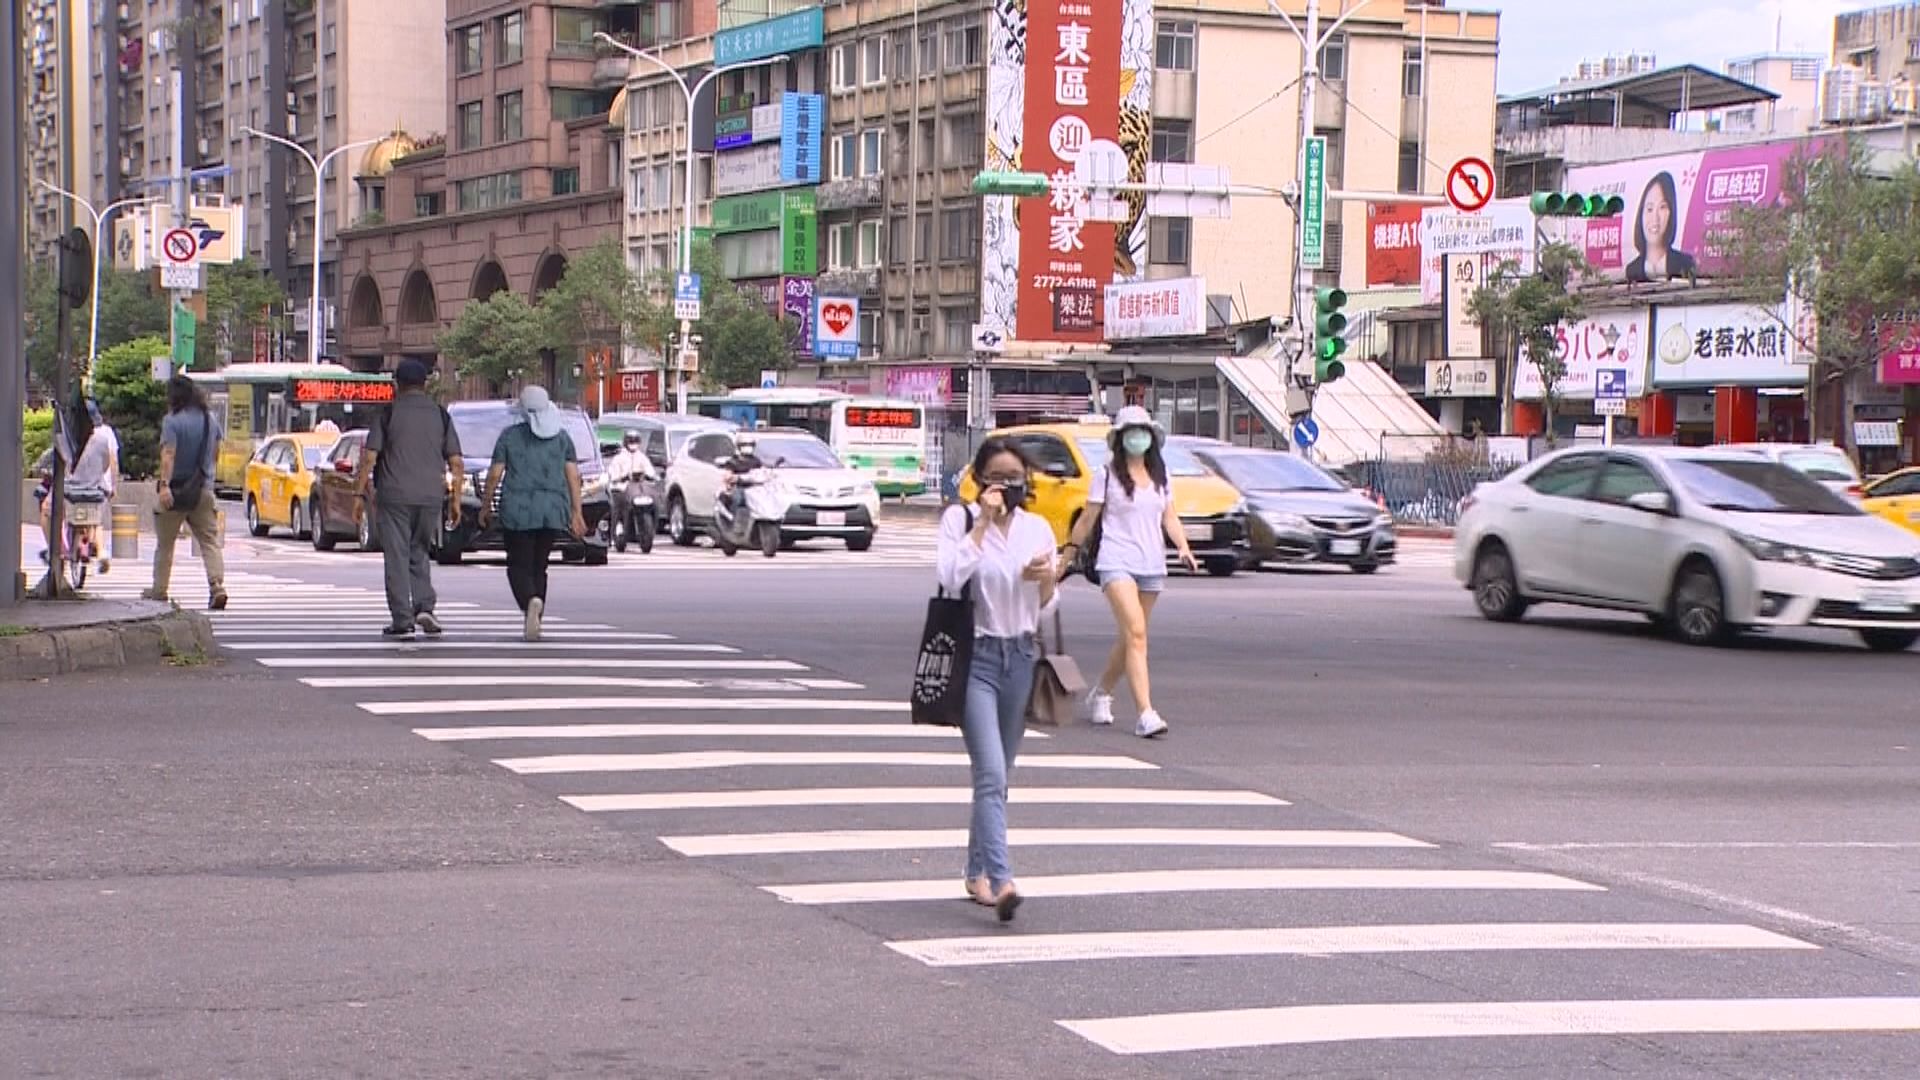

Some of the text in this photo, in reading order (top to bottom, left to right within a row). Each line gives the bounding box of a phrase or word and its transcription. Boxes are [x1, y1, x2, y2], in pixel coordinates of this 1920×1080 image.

[1711, 172, 1761, 198] 聯絡站
[1060, 293, 1094, 316] 樂法
[621, 374, 649, 391] GNC
[1598, 371, 1614, 391] P
